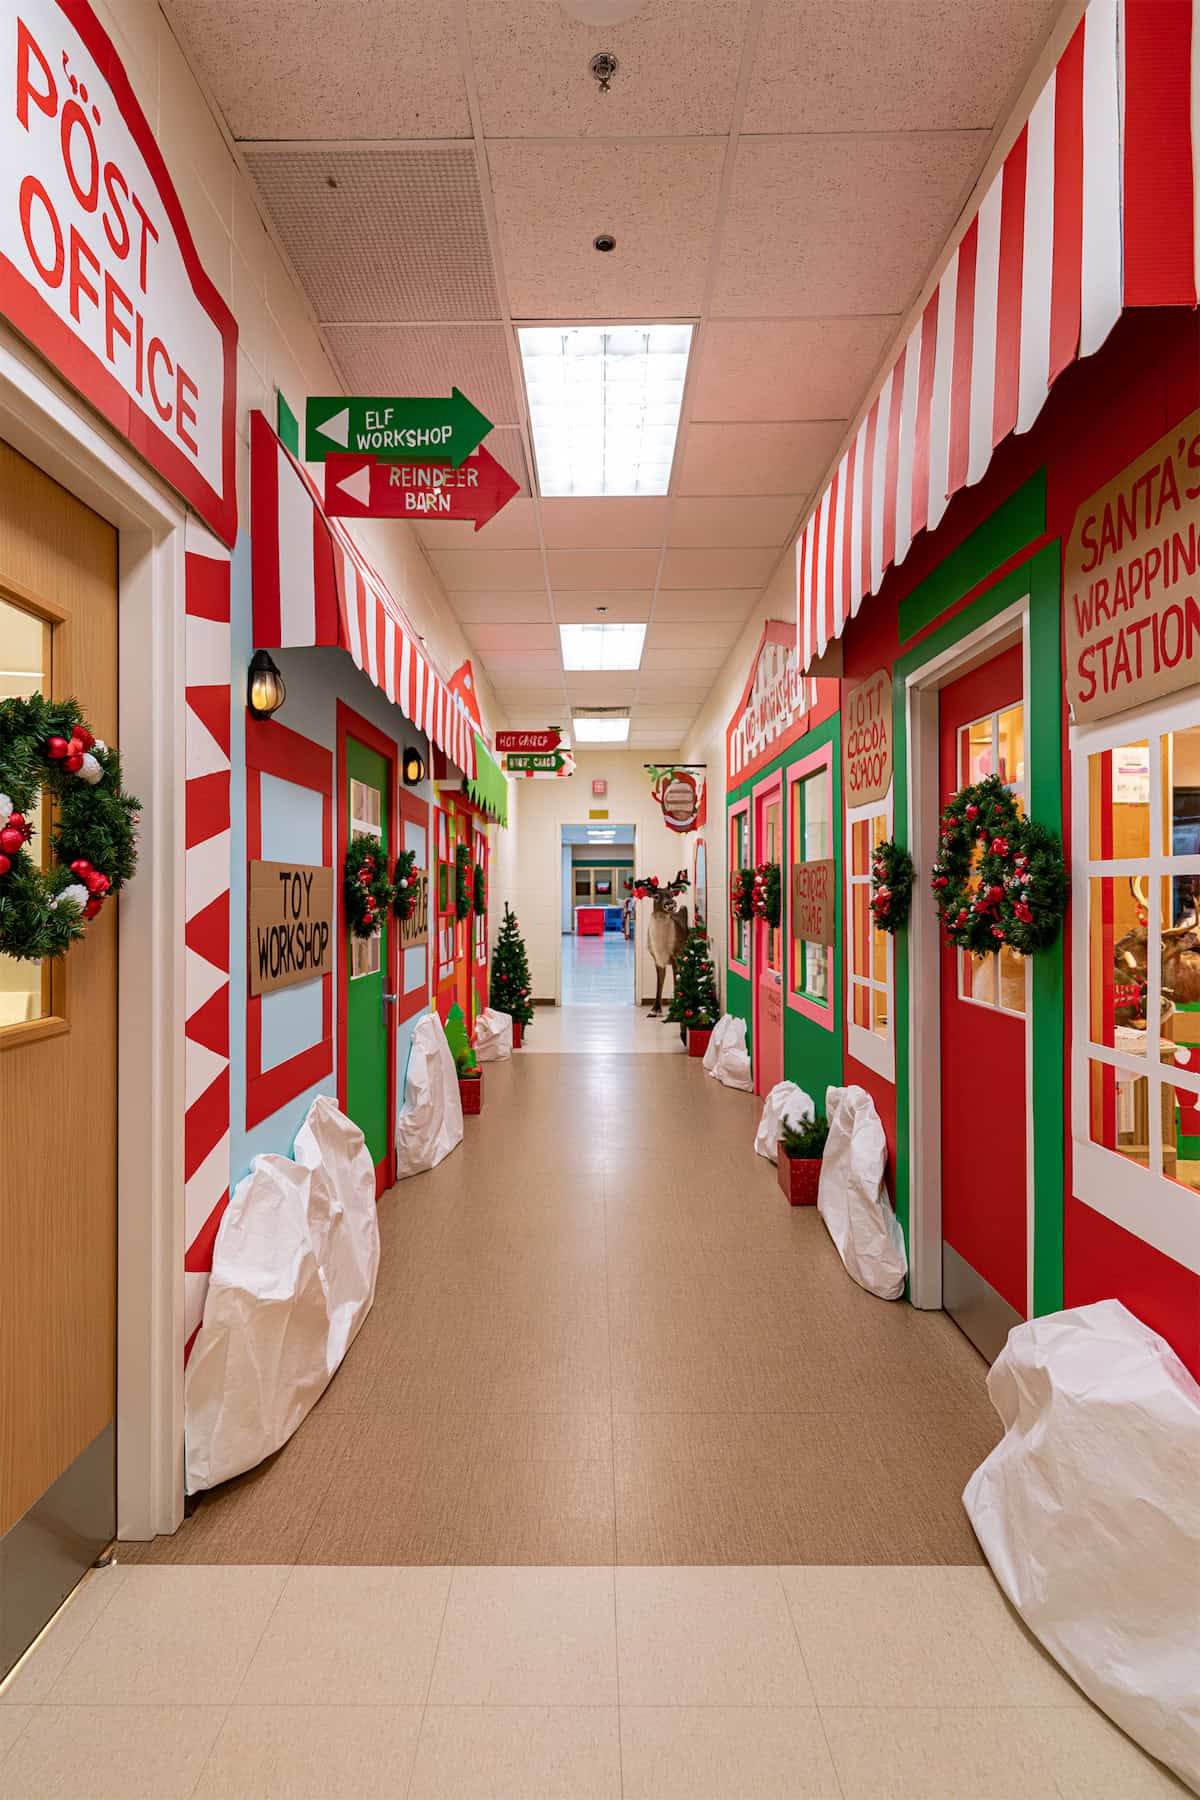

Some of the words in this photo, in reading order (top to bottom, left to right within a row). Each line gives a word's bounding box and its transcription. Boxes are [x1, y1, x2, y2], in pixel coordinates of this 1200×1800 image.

[17, 16, 159, 295] POST
[19, 175, 199, 458] OFFICE
[356, 425, 453, 450] WORKSHOP
[365, 408, 394, 430] ELF
[388, 467, 479, 488] REINDEER
[405, 492, 451, 513] BARN
[1081, 432, 1200, 573] SANTA'S
[1073, 523, 1200, 638] WRAPPIN
[279, 871, 313, 920] TOY
[257, 921, 328, 980] WORKSHOP
